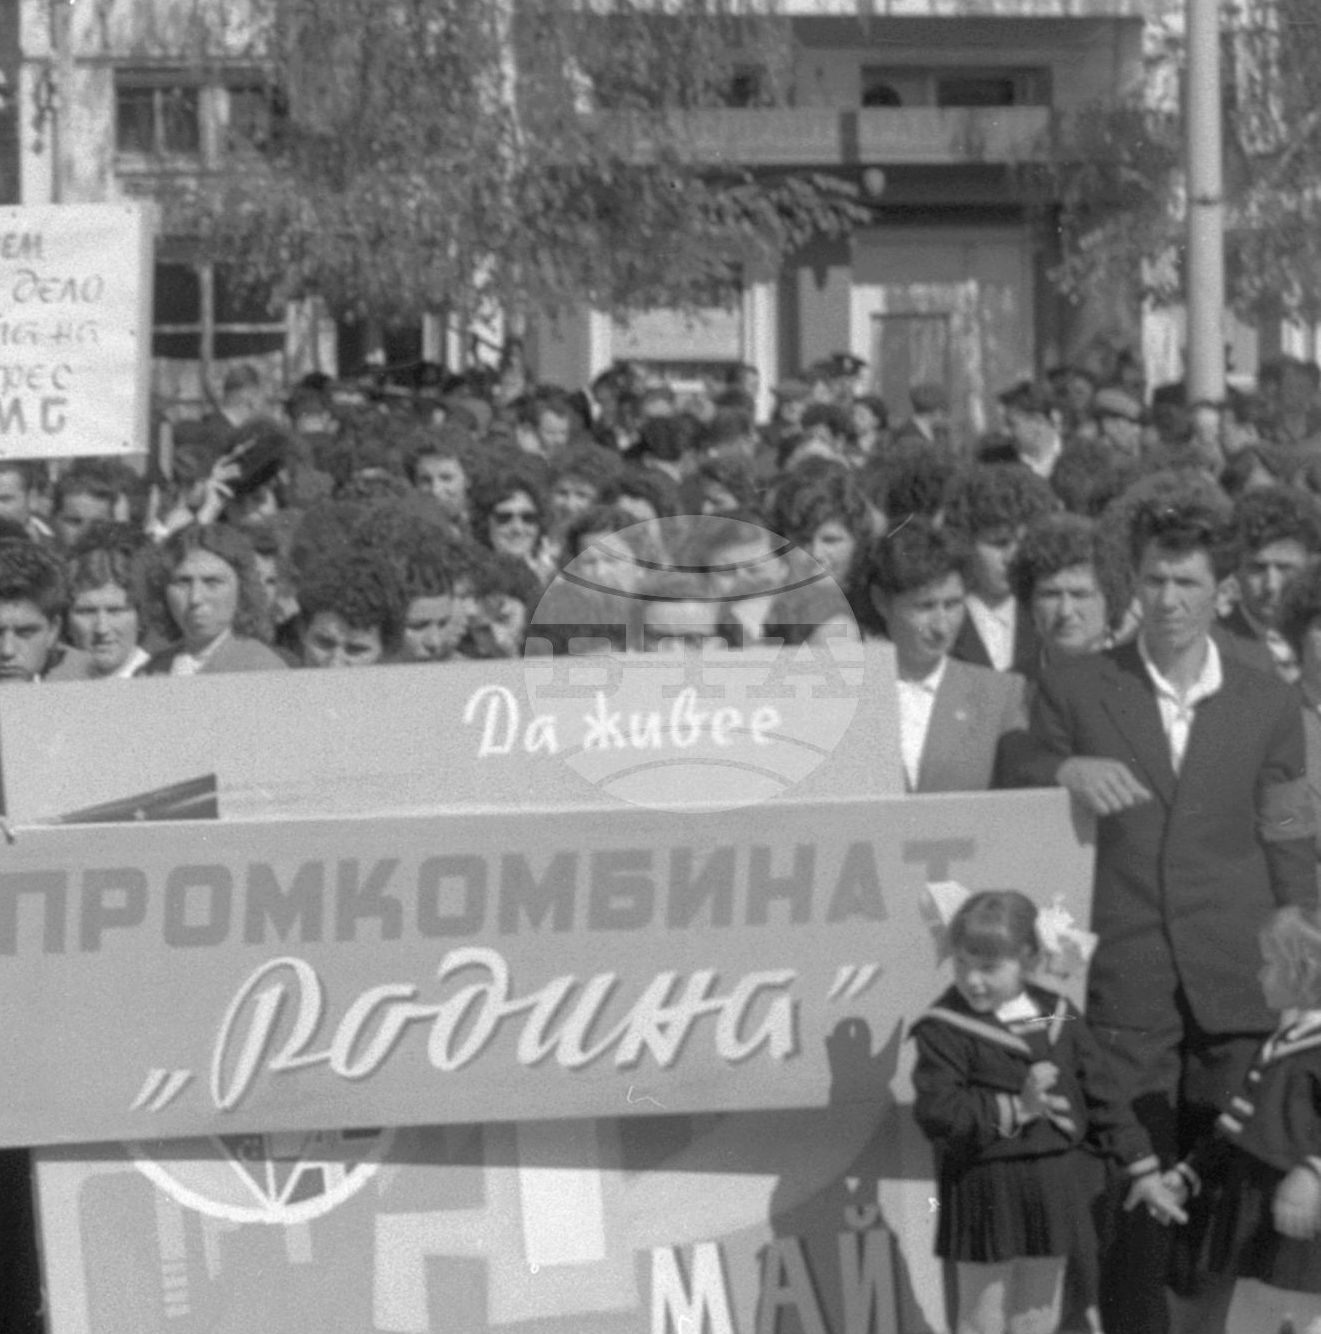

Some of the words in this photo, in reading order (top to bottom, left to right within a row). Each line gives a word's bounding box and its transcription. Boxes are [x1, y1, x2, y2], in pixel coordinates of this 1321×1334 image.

[11, 268, 105, 306] дело
[463, 684, 559, 758] Да
[582, 687, 785, 750] живее
